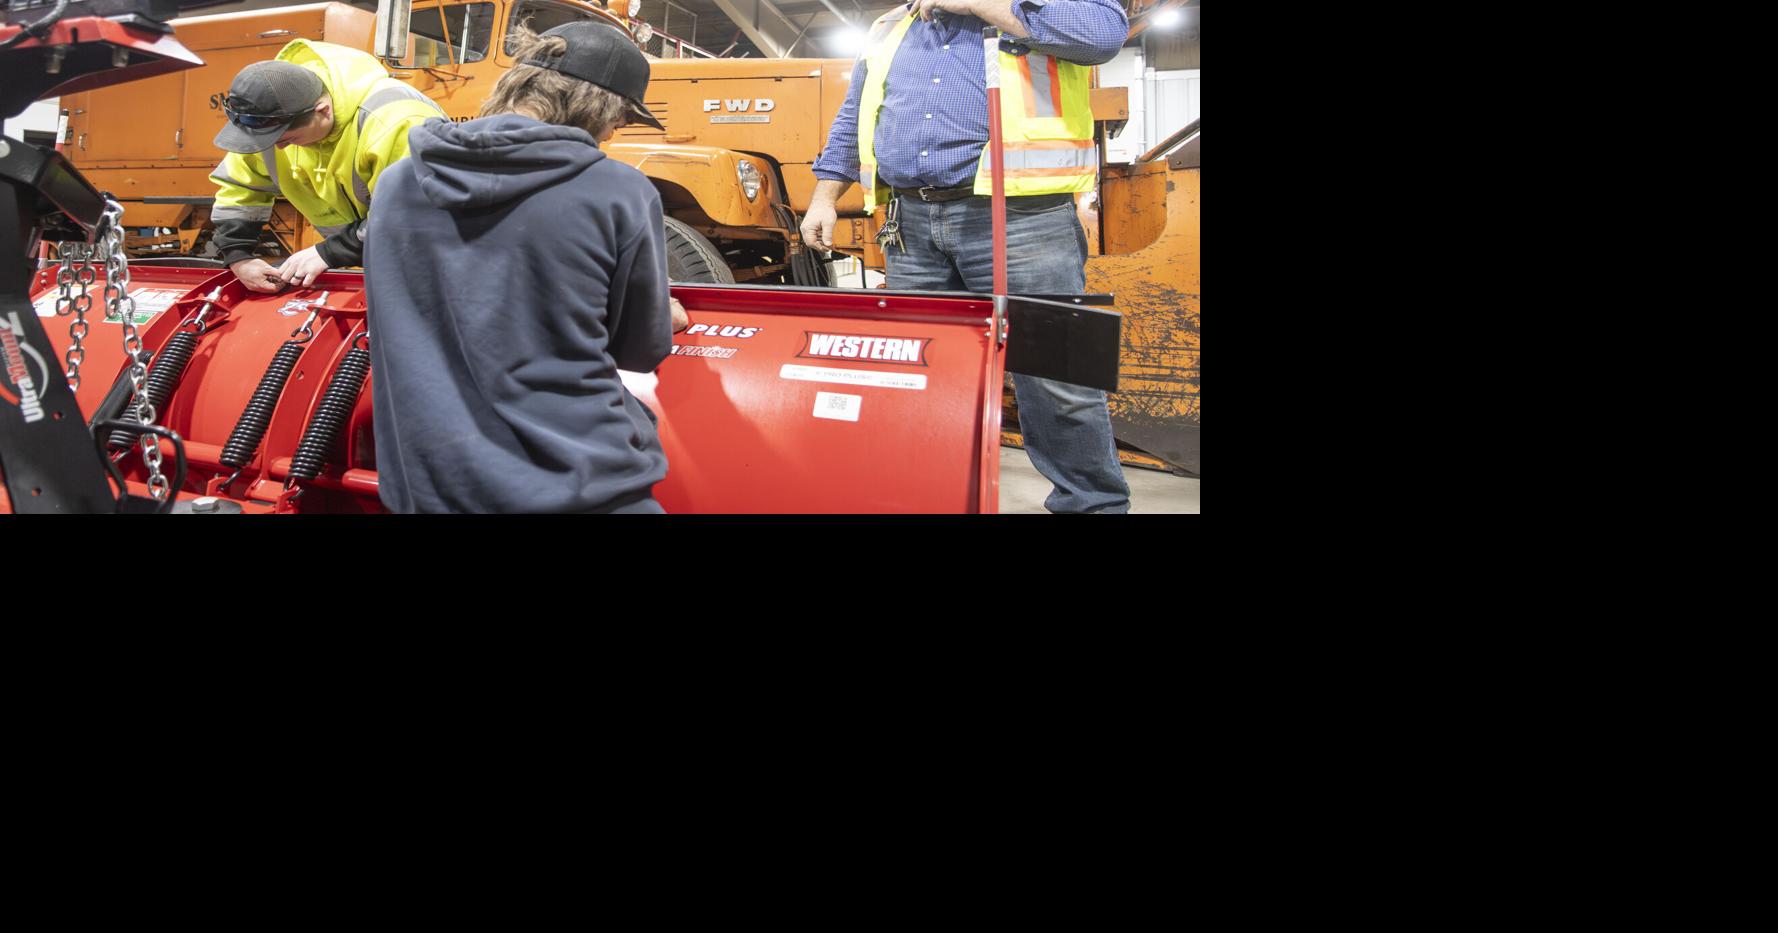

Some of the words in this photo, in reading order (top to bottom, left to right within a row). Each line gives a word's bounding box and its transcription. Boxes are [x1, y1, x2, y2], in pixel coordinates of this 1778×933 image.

[703, 98, 775, 112] FWD
[686, 323, 757, 338] PLUS
[809, 333, 921, 362] WESTERN
